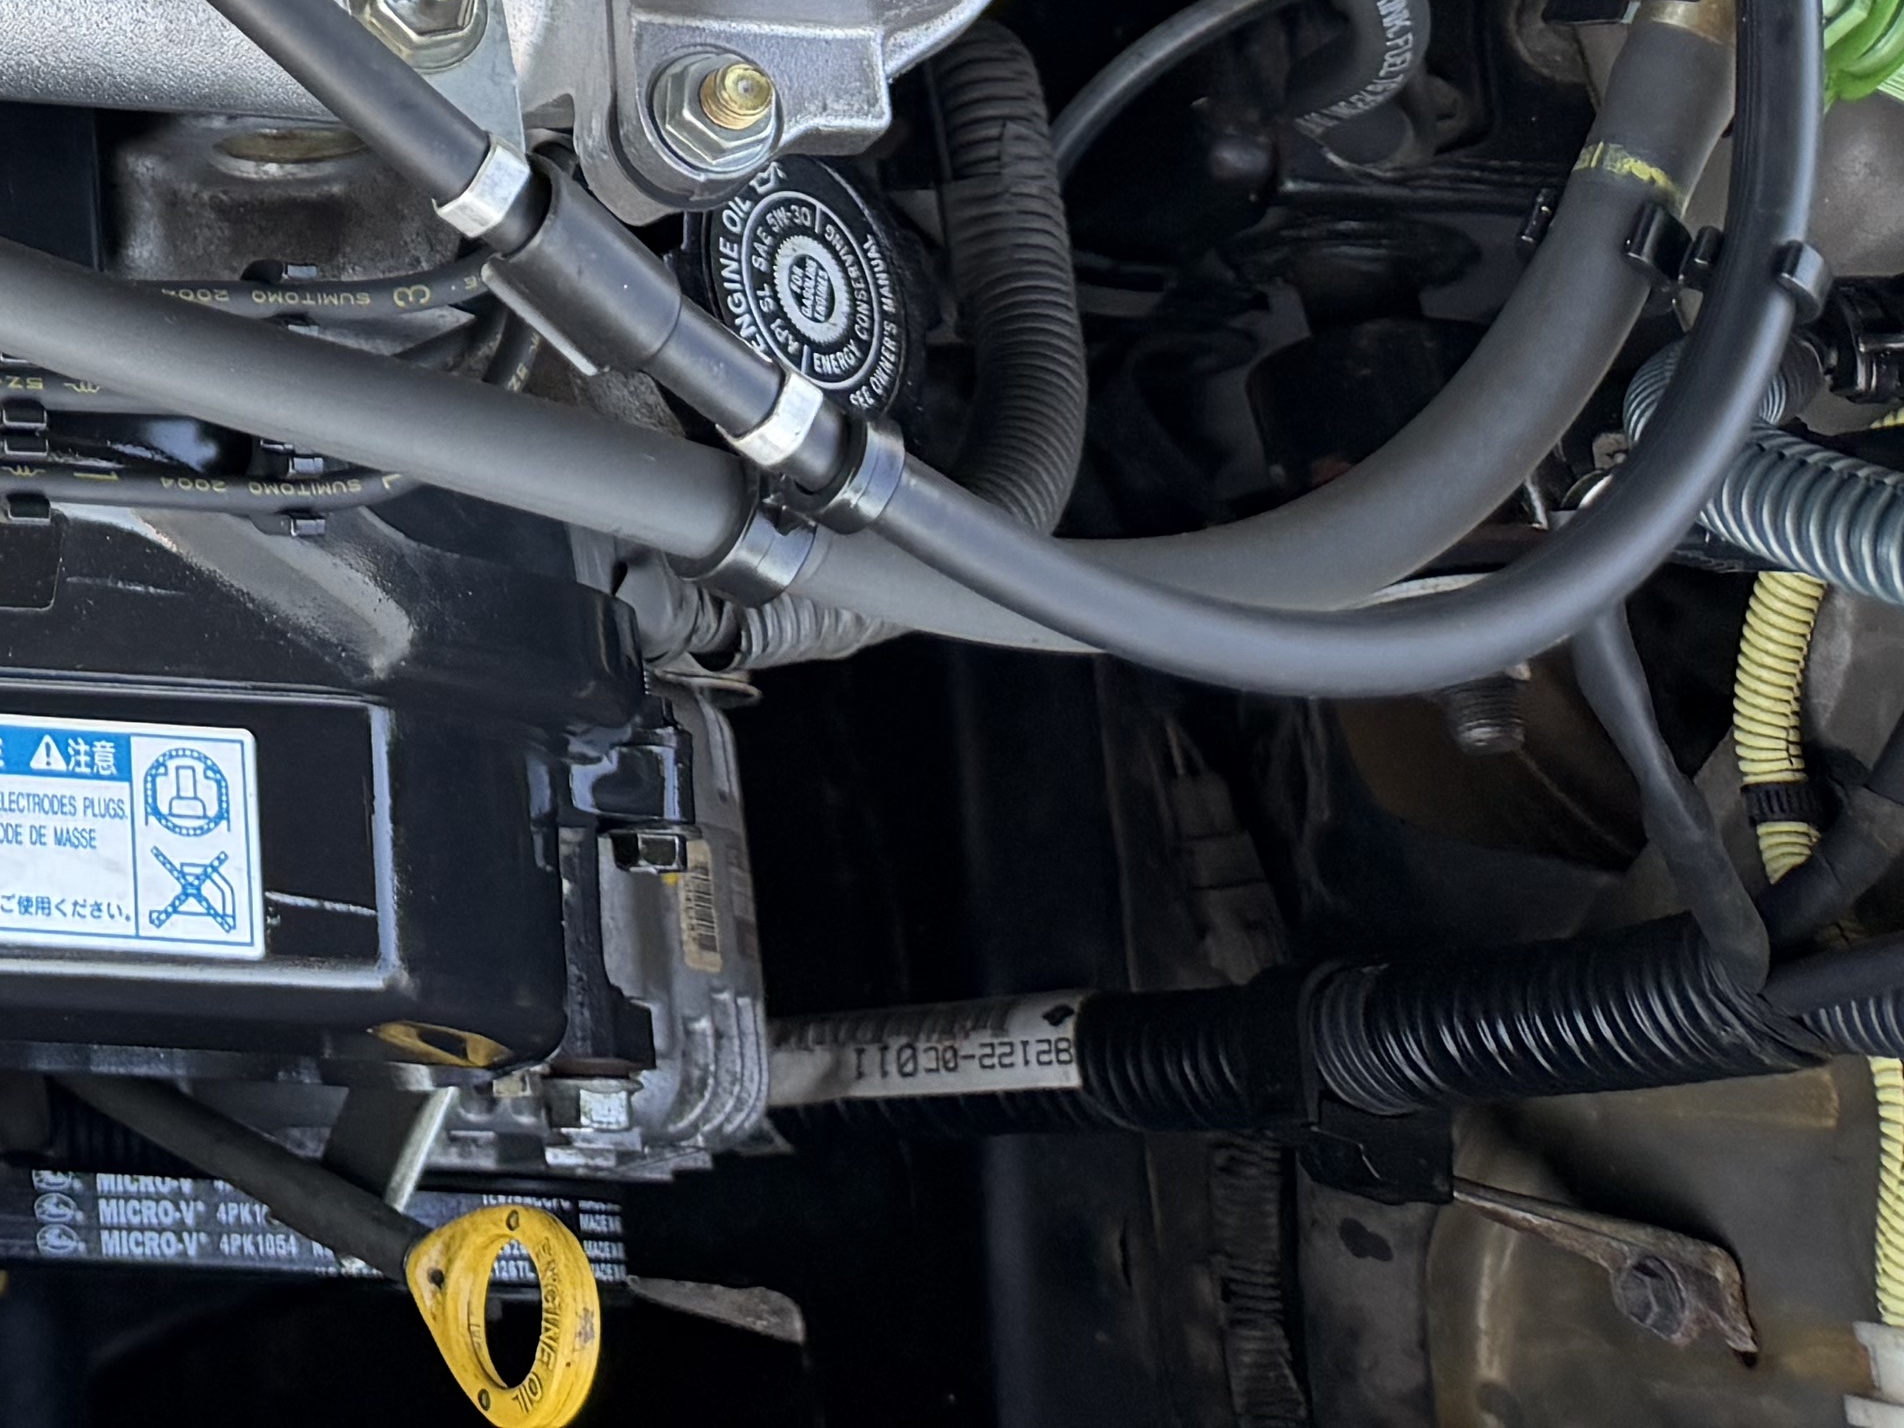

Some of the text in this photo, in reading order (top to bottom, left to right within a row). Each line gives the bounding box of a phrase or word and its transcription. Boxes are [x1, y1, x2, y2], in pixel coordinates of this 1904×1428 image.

[1378, 34, 1414, 79] FUEL
[751, 227, 773, 274] SAE
[719, 196, 766, 358] ENGINE OIL
[250, 290, 373, 308] SUMITOMO
[757, 283, 777, 312] SL
[770, 317, 802, 354] API
[813, 340, 863, 375] ENERGY
[160, 476, 227, 493] 2004
[248, 477, 362, 495] SUMITOMO
[68, 737, 116, 776] 注意
[83, 796, 129, 820] PLUGS.
[30, 826, 47, 846] DE
[54, 828, 97, 850] MASSE
[511, 1372, 544, 1414] OIL
